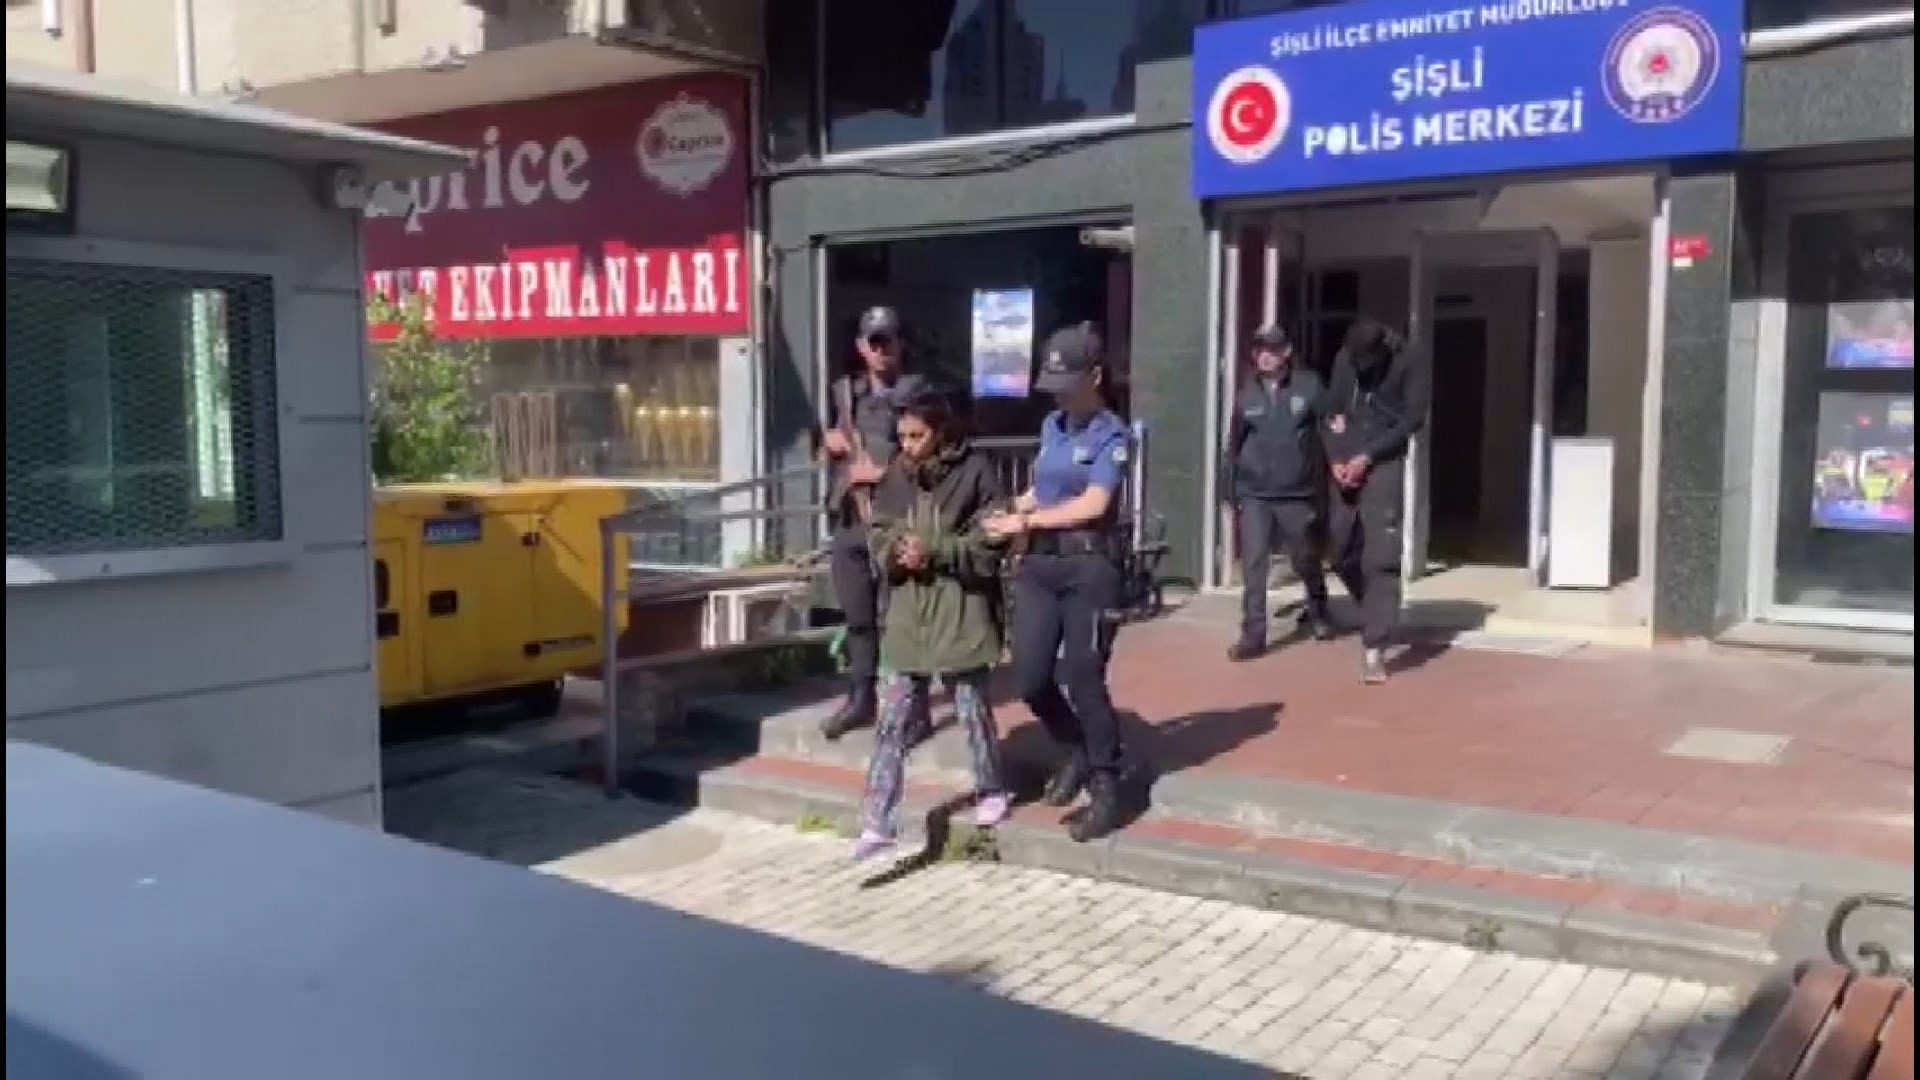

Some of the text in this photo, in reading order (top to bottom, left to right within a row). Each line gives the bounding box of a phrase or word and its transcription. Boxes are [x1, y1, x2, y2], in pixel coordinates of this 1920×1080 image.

[1375, 8, 1475, 42] EMNİYET
[1391, 45, 1484, 104] ŞİŞLİ
[1303, 109, 1404, 160] POLİS
[1412, 86, 1583, 147] MERKEZİ
